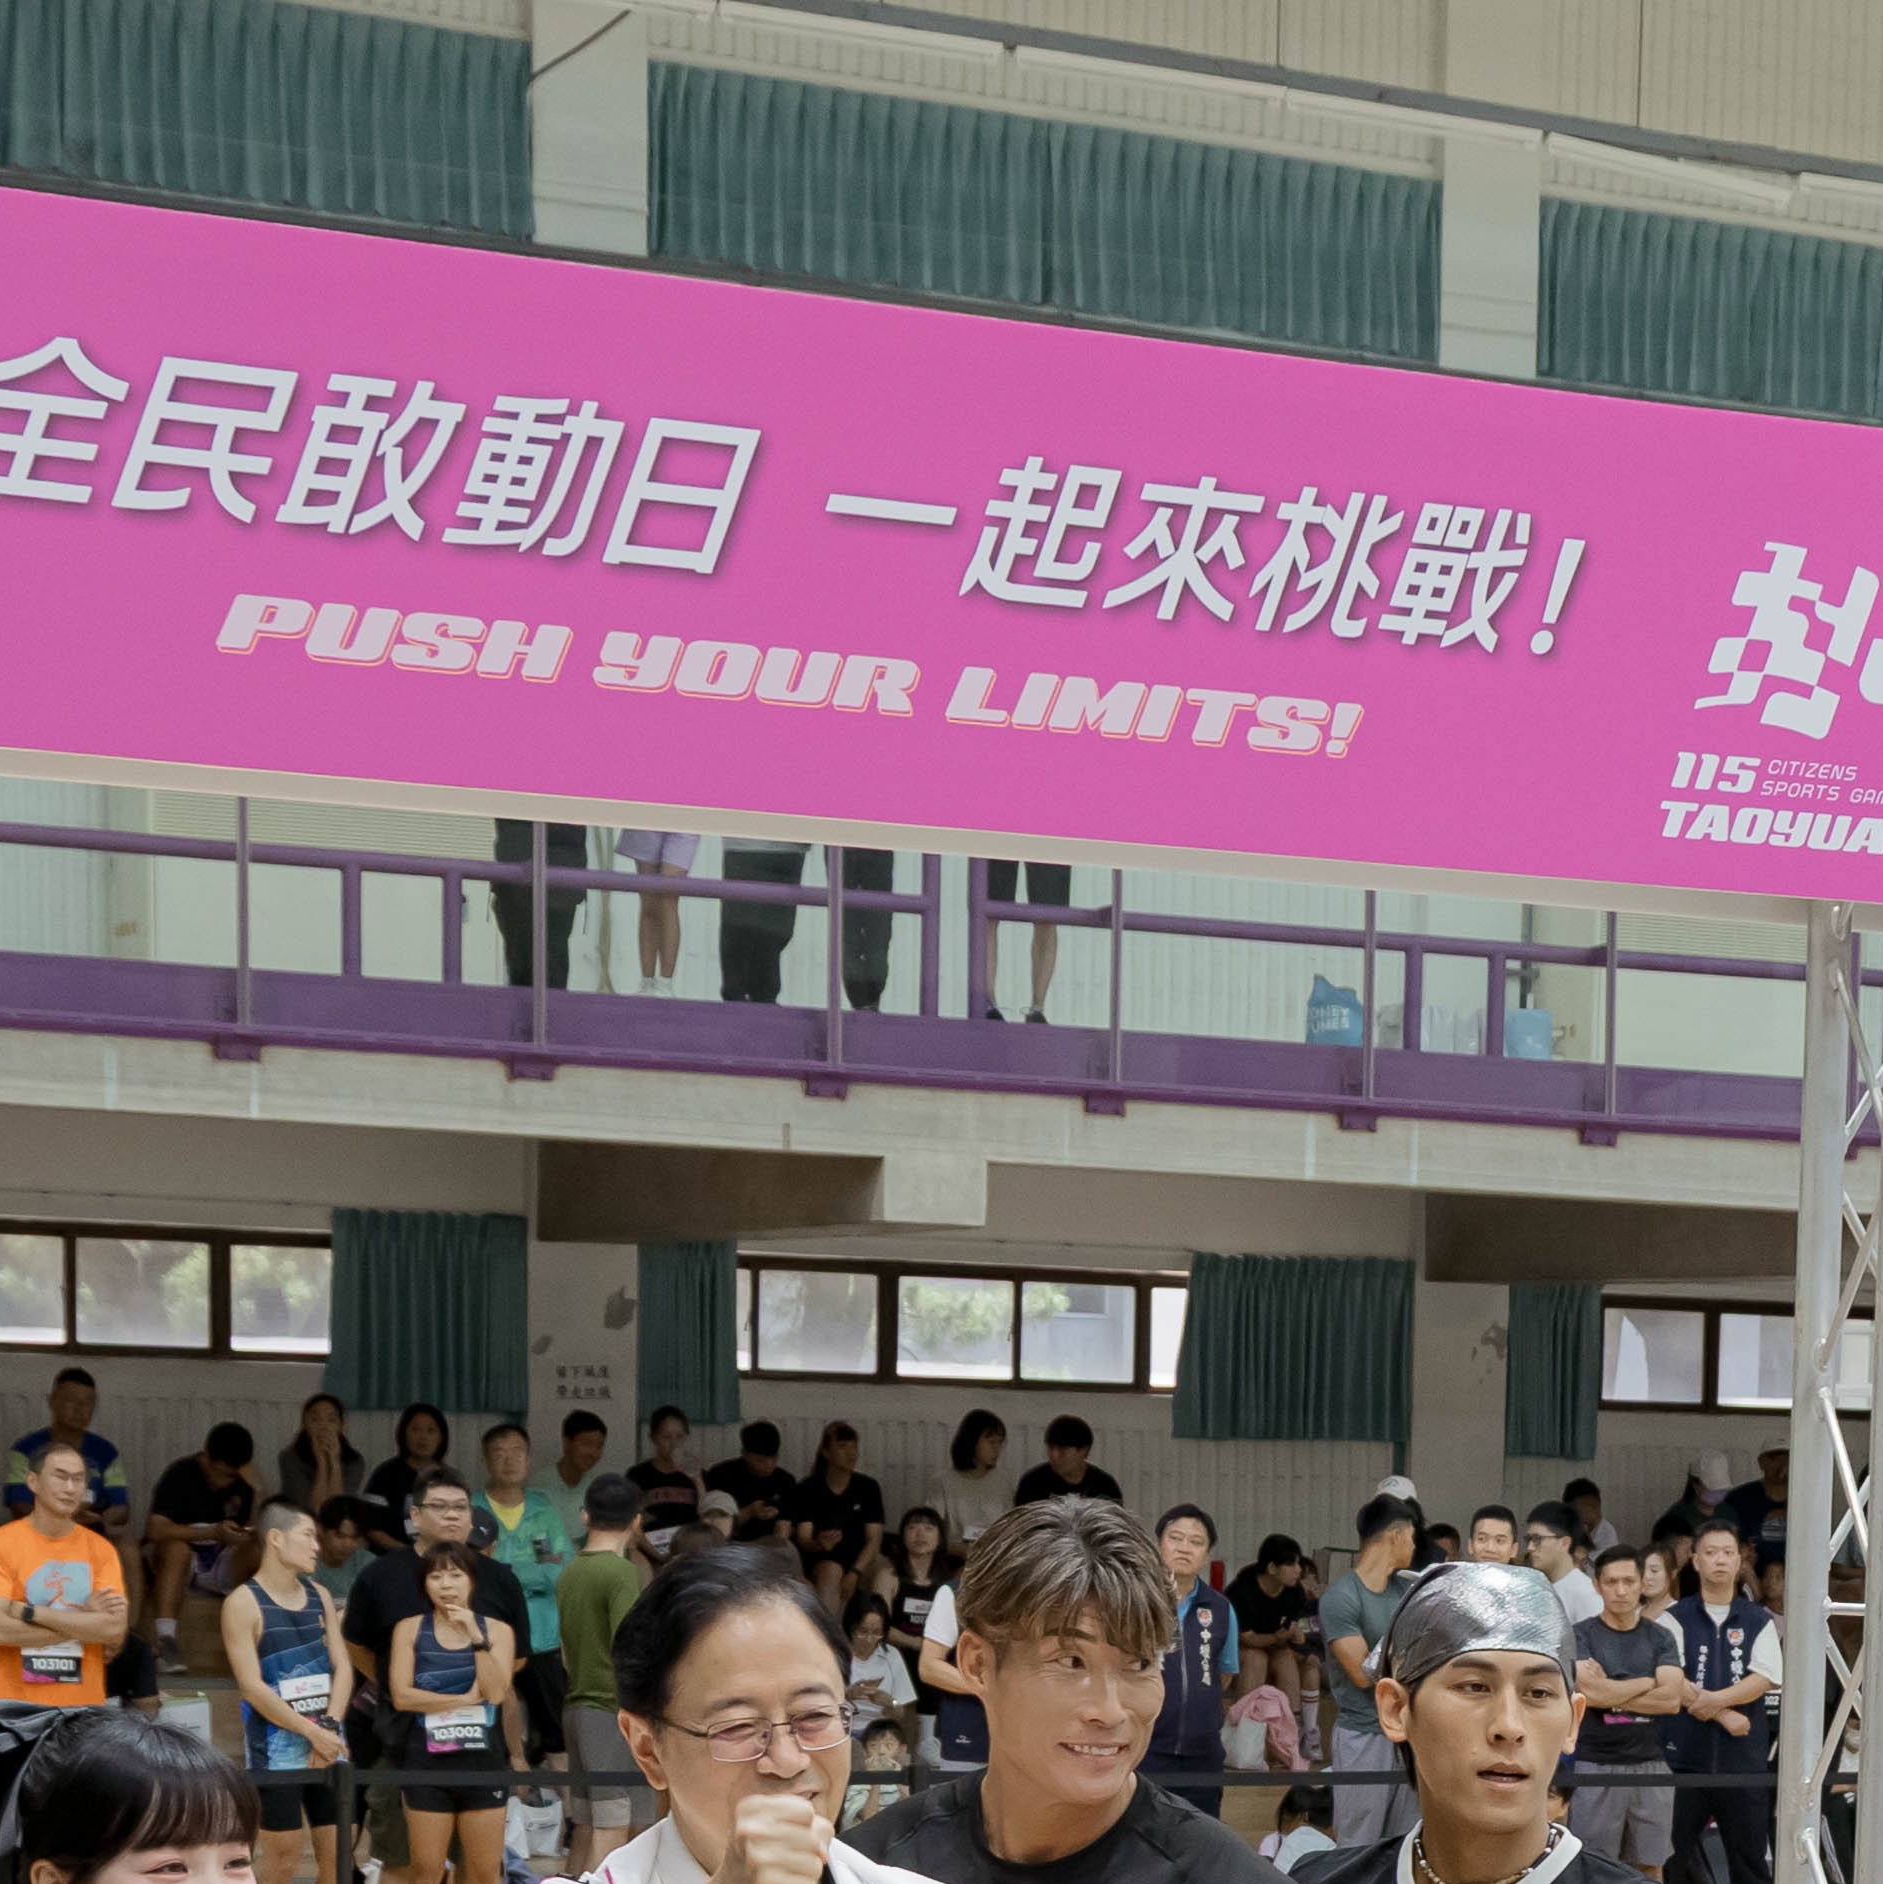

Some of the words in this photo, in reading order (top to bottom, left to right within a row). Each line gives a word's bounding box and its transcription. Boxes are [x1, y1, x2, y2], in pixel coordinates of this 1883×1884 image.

[216, 593, 574, 683] PUSH
[592, 631, 921, 717] YOUR
[945, 666, 1365, 760] LIMITS!
[1670, 751, 1762, 794] 115
[1767, 759, 1858, 782] CITIZENS
[1759, 780, 1841, 802] SPORTS
[31, 1657, 75, 1672] 103101
[432, 1725, 483, 1741] 103002
